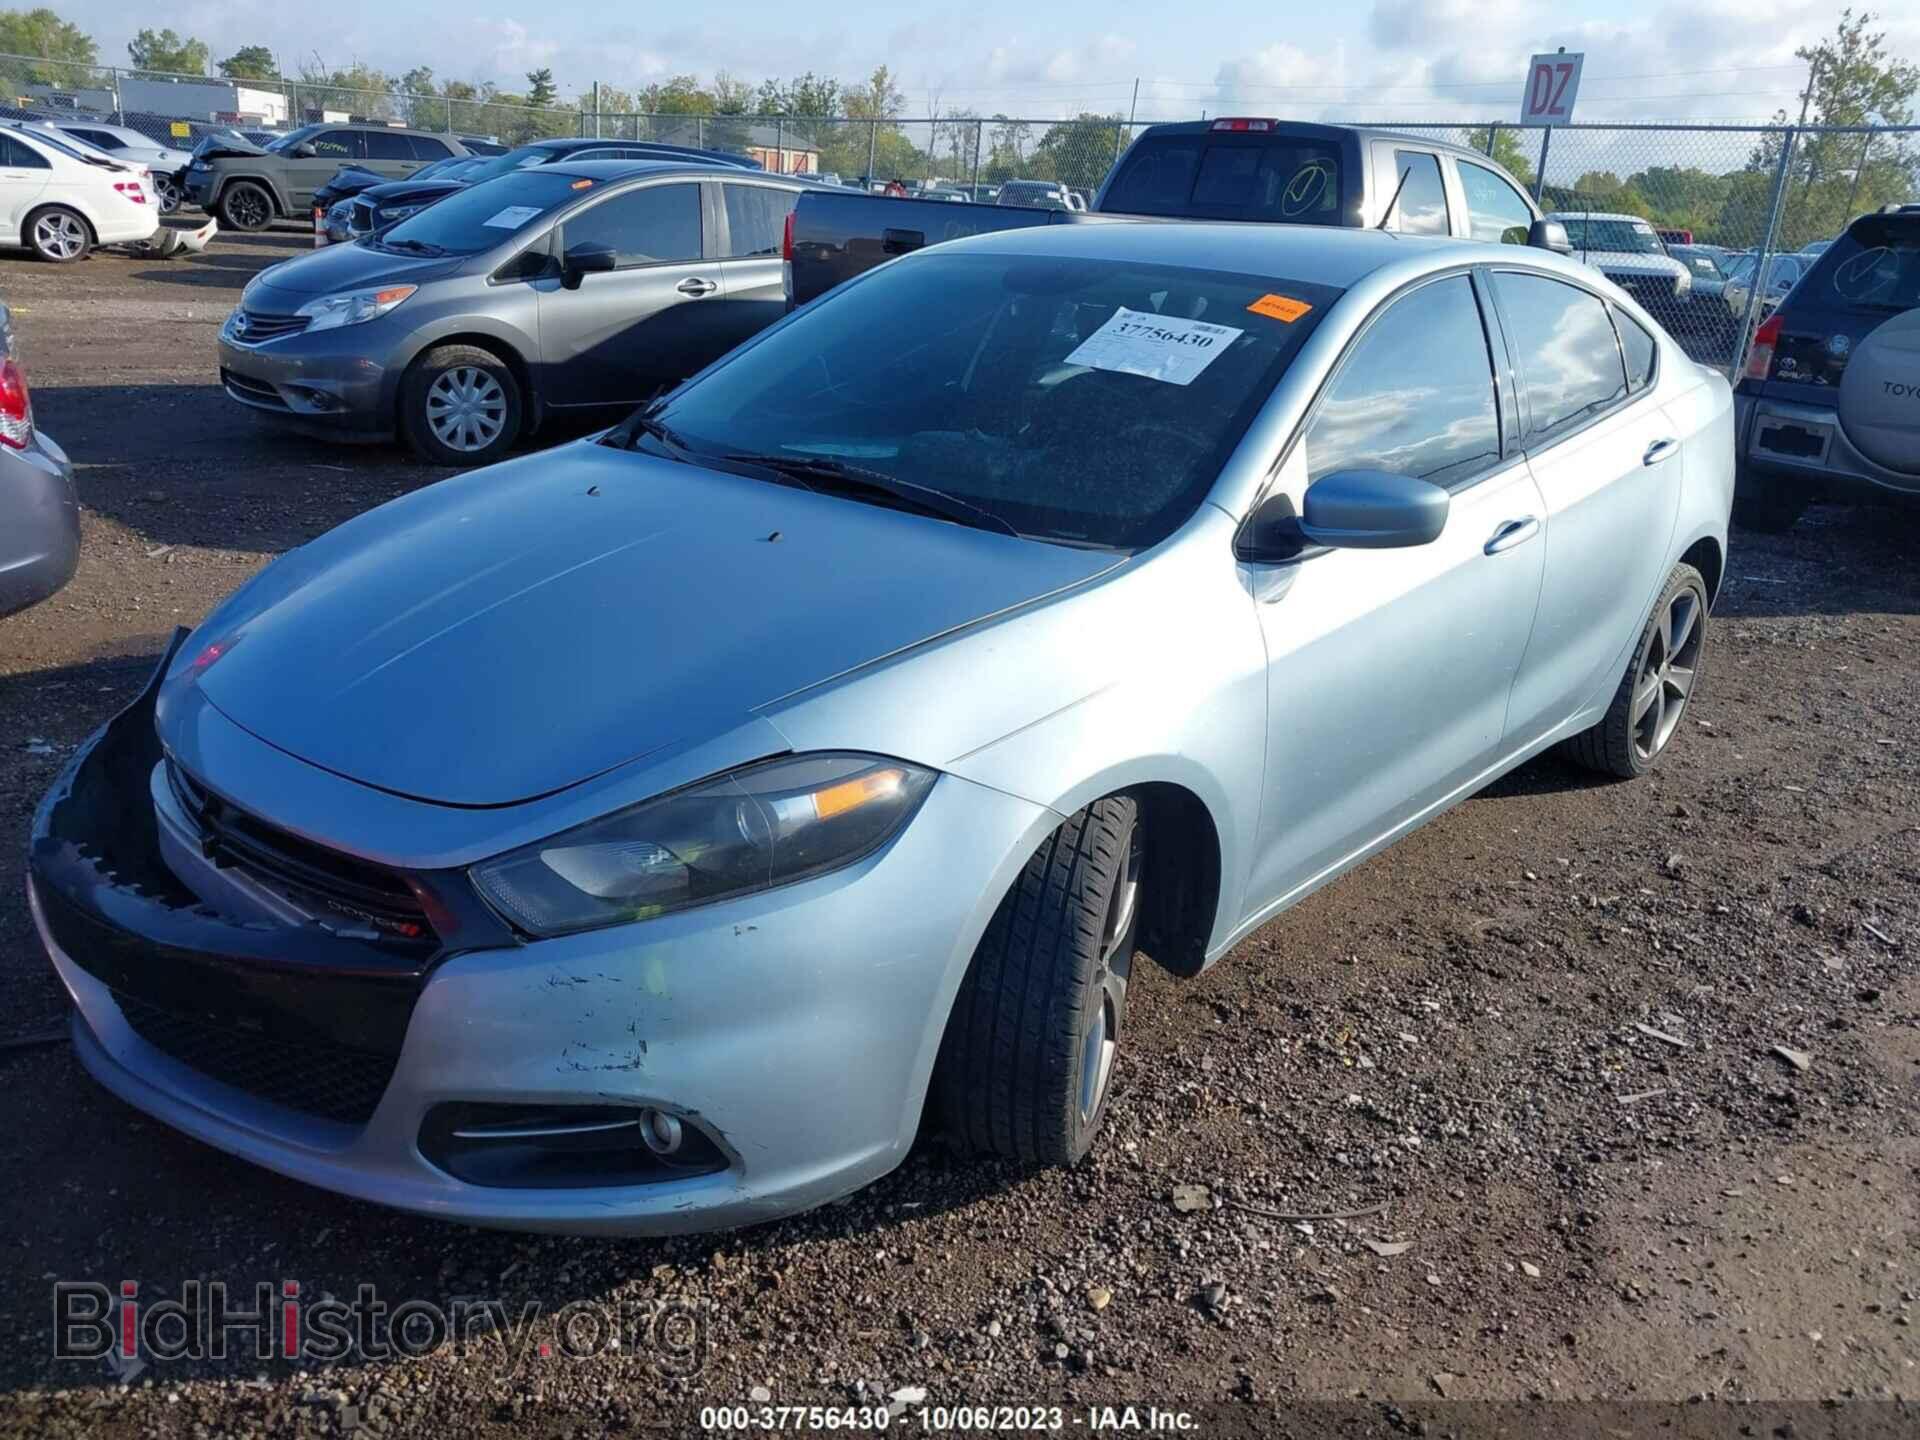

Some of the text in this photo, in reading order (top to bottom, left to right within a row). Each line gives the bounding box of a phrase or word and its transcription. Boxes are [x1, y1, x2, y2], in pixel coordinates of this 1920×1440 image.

[1528, 63, 1574, 115] DZ
[1112, 322, 1213, 348] 37756430
[1883, 382, 1920, 399] TOY
